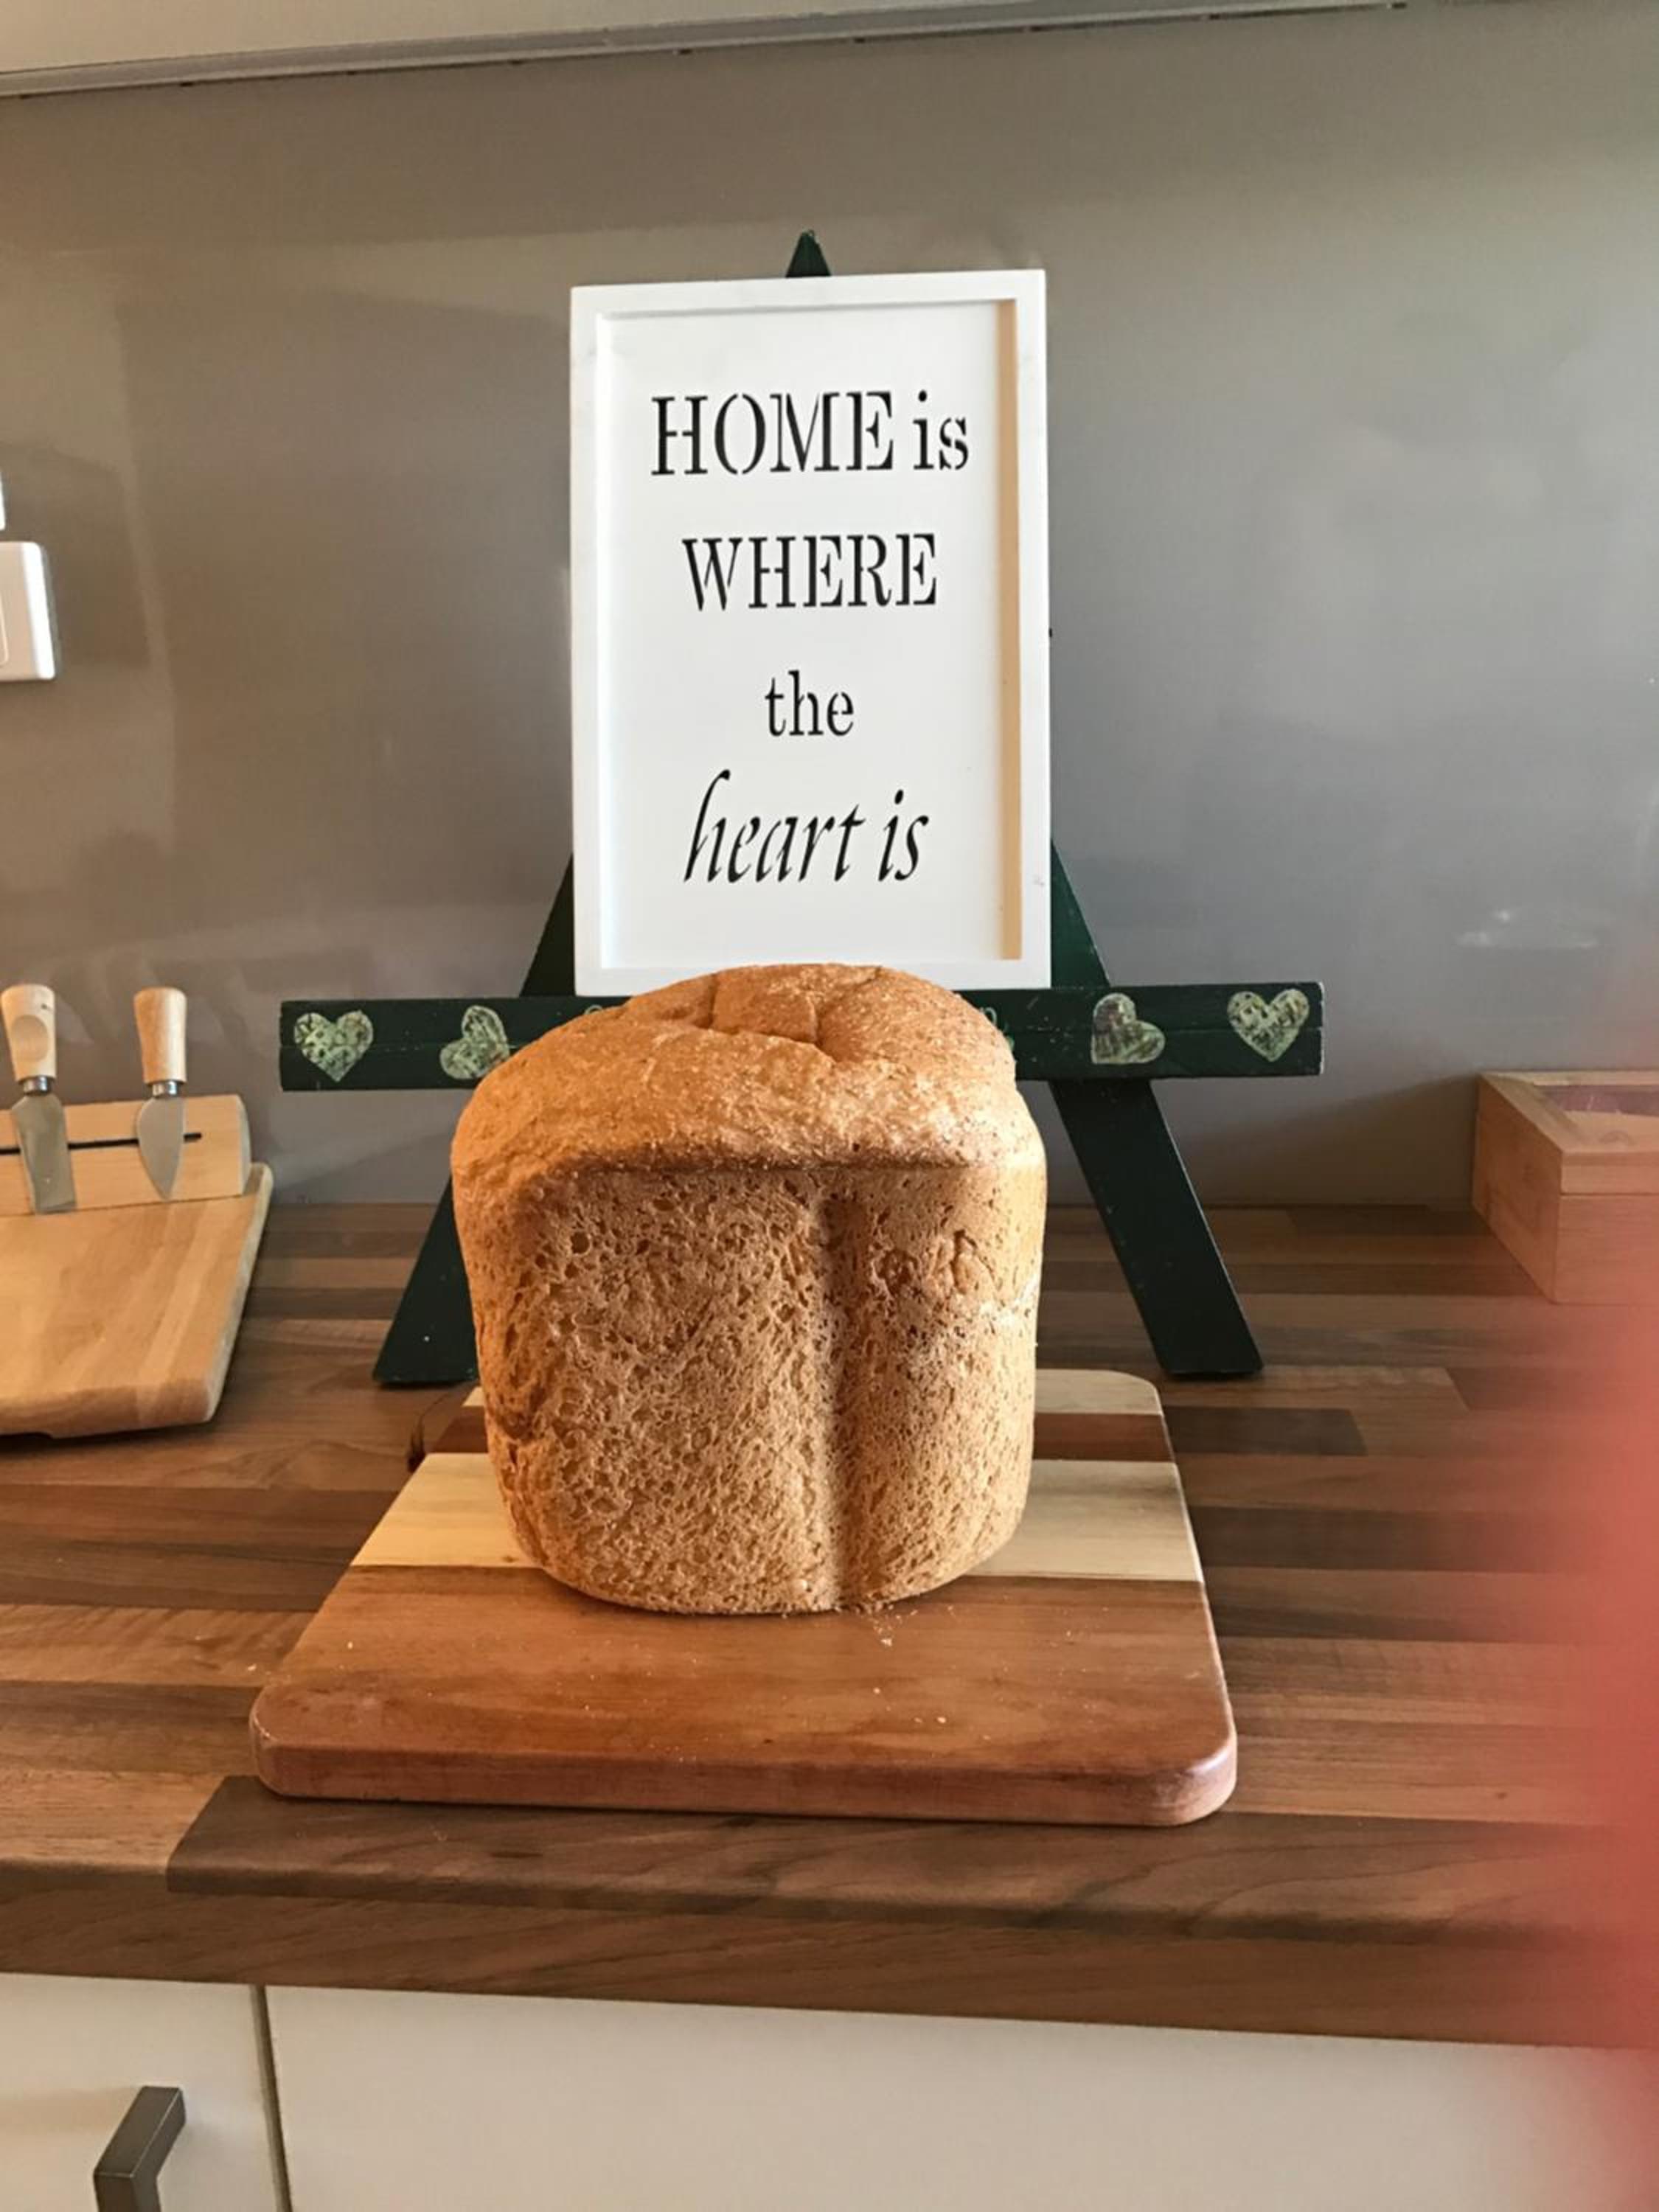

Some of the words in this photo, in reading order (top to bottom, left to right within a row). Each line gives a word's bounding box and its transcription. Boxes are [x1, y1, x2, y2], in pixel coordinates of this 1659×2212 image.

[650, 389, 894, 476] HOME
[912, 389, 970, 471] is
[681, 532, 937, 612] WHERE
[764, 669, 855, 737] the
[683, 768, 866, 883] heart
[877, 788, 930, 883] is
